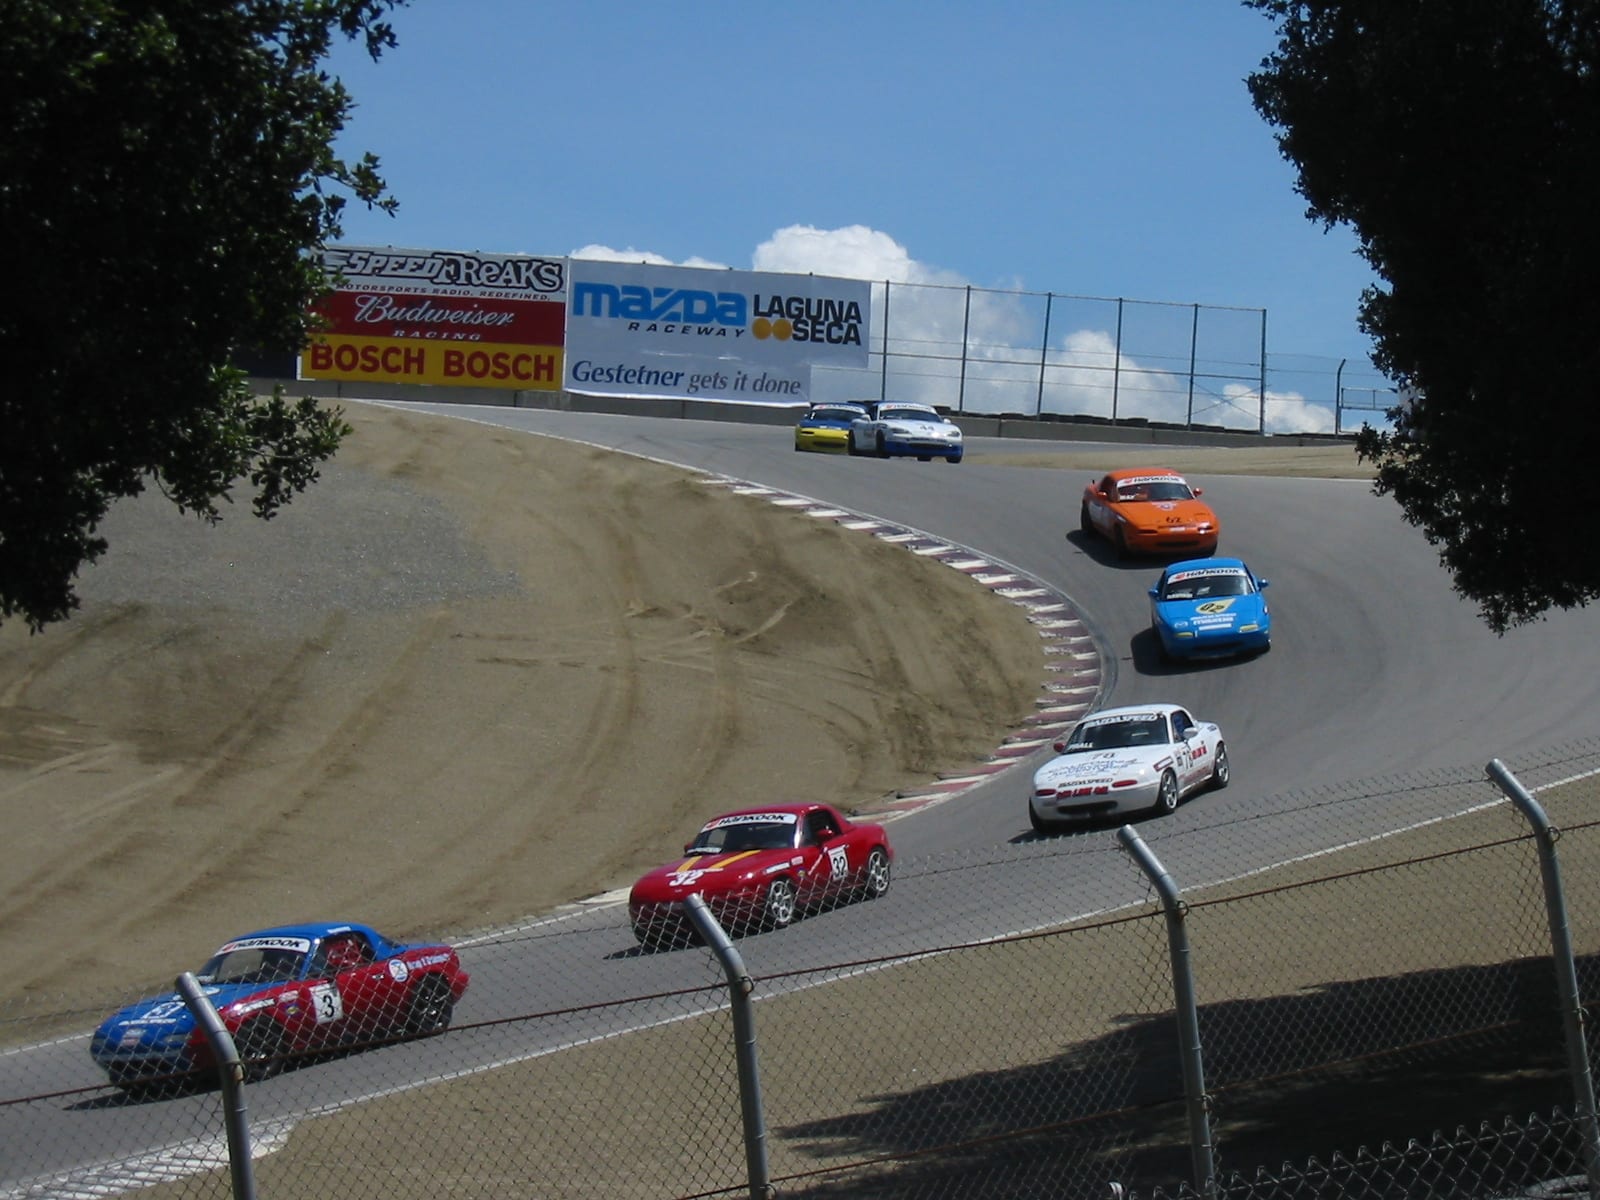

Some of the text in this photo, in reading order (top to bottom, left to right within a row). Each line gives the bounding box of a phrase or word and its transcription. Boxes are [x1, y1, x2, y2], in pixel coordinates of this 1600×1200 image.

[355, 295, 515, 327] Budweiser
[753, 294, 862, 325] LAGUNA
[392, 328, 481, 342] RACING
[628, 320, 746, 339] RACEWAY
[791, 318, 862, 346] SECA
[311, 343, 555, 382] BOSCH BOSCH
[572, 360, 801, 394] Gestetner gets it done
[833, 856, 846, 878] 32
[322, 995, 335, 1018] 3
